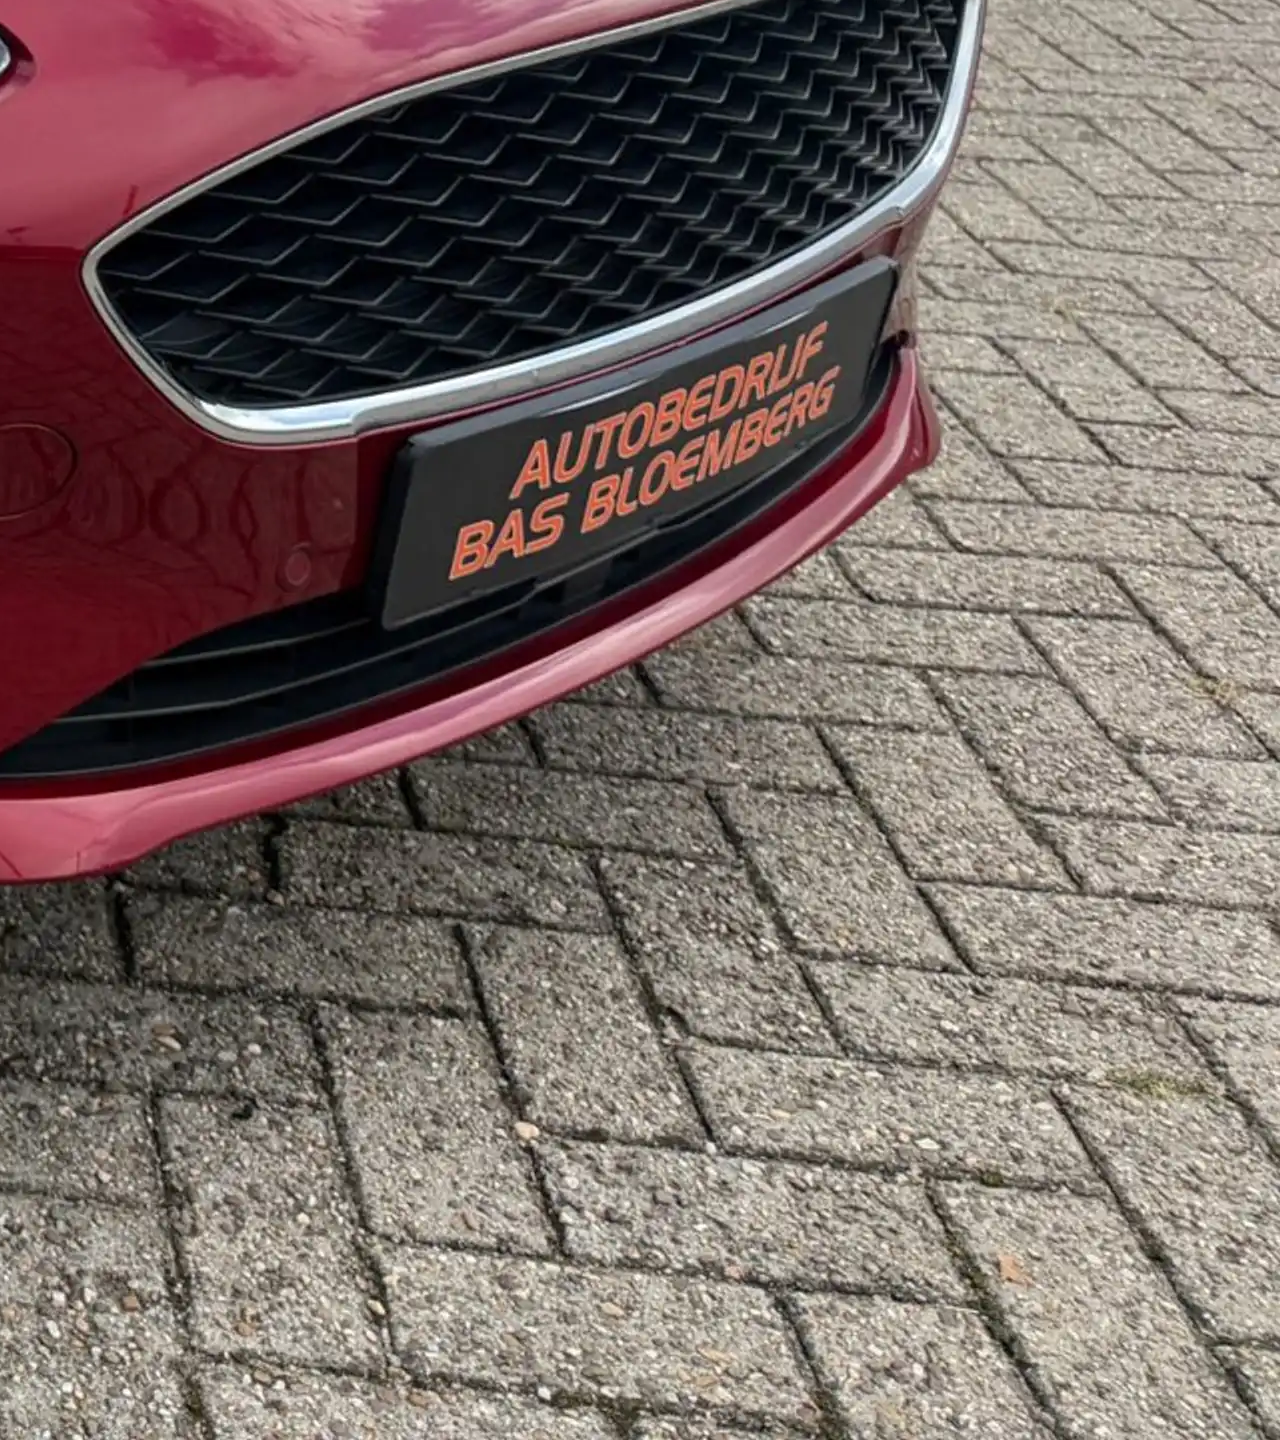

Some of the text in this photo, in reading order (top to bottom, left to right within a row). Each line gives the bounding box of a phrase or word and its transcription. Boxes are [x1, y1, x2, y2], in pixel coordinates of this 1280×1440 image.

[447, 364, 842, 581] BAS BLOEMBERG
[509, 320, 829, 500] AUTOBEDRIJF
